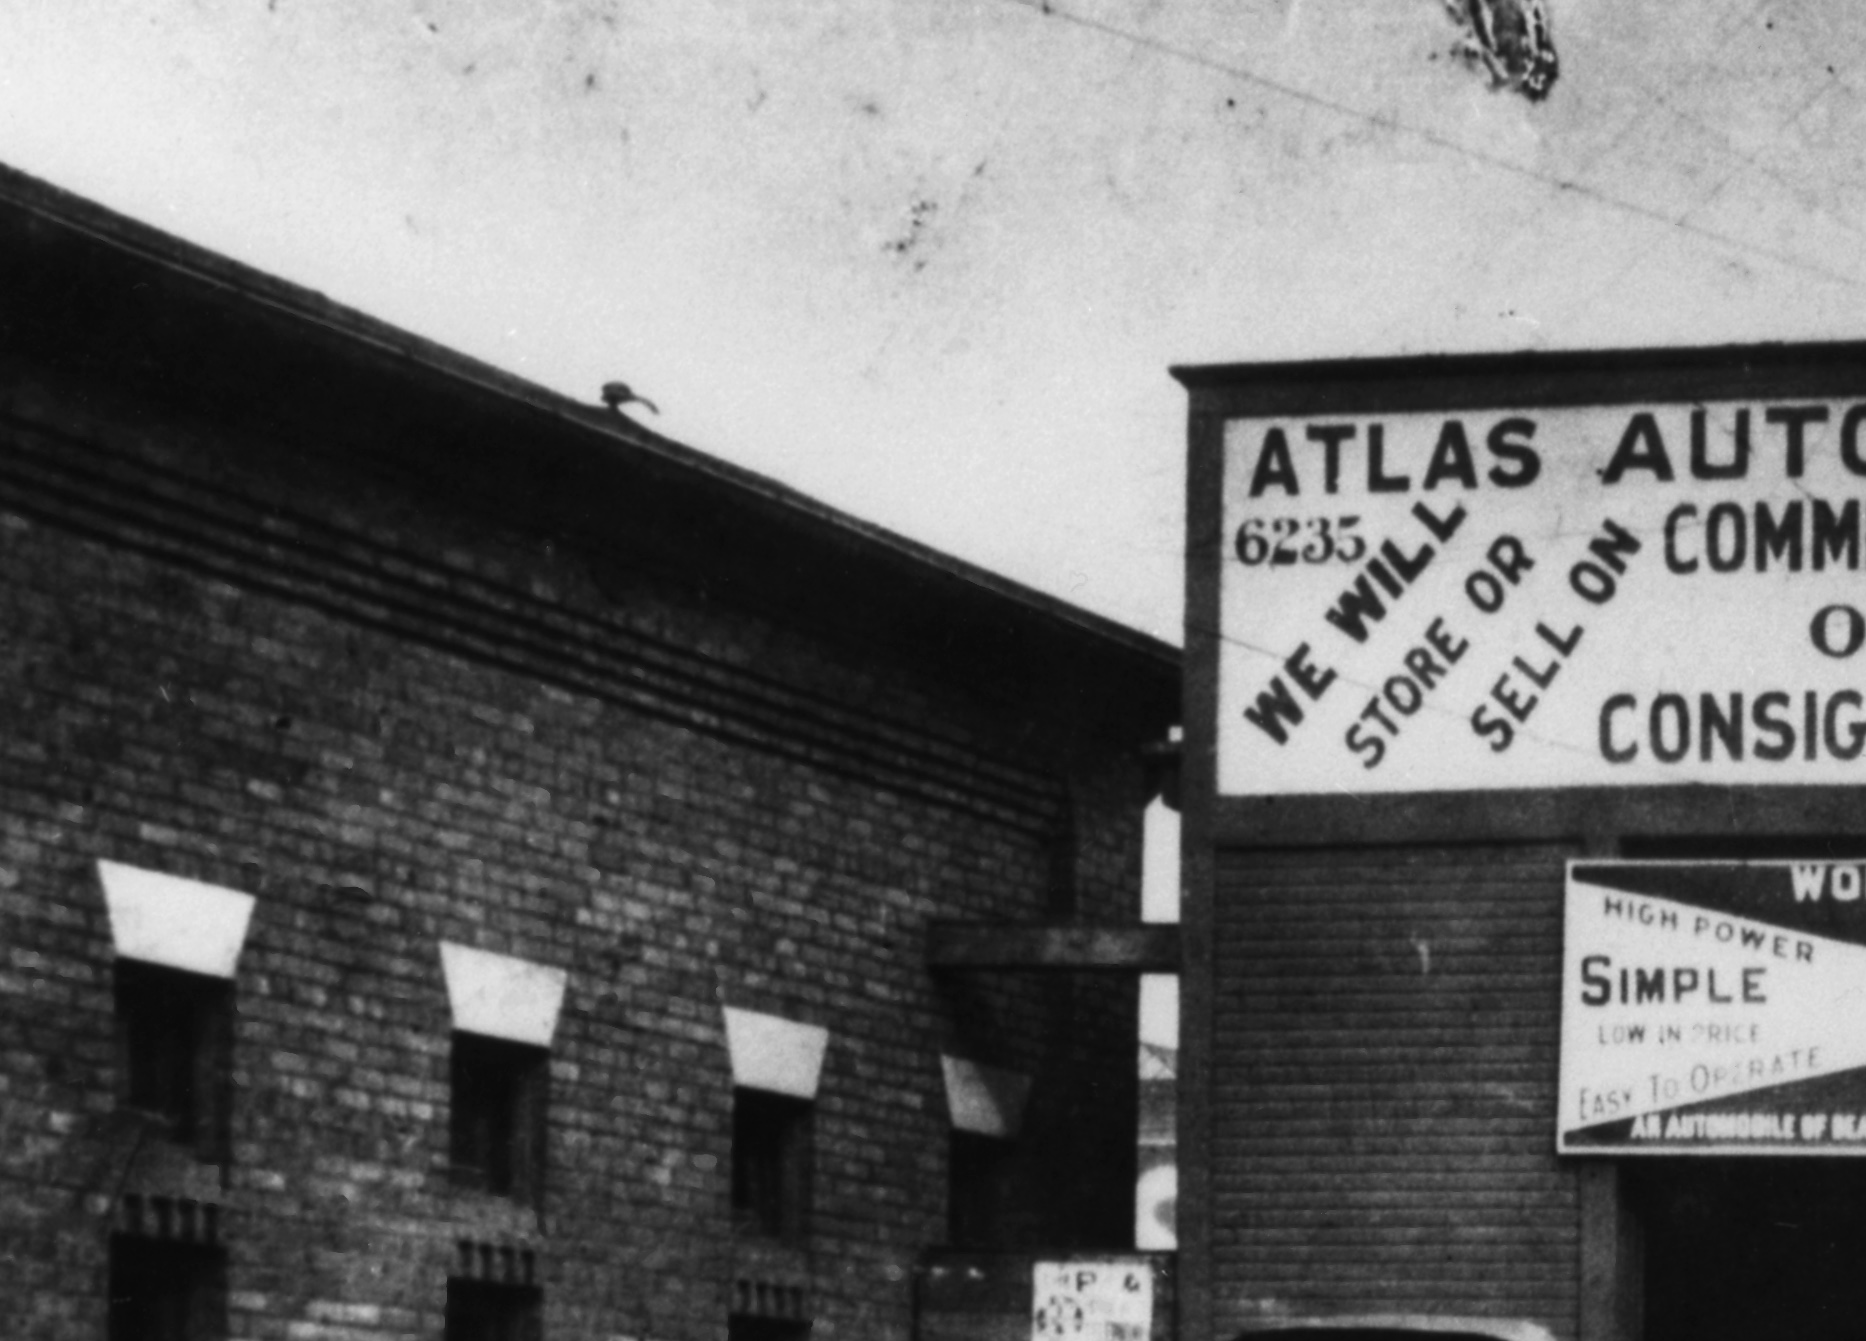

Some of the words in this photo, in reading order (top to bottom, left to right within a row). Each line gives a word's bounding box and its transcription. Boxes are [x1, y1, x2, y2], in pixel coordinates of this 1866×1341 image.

[1249, 417, 1541, 497] ATLAS
[1234, 515, 1367, 566] 6235
[1244, 642, 1337, 746] WE
[1325, 498, 1467, 643] WILL
[1344, 617, 1469, 769] STORE
[1464, 535, 1535, 613] OR
[1470, 620, 1585, 753] SELL
[1569, 519, 1642, 603] ON
[1603, 897, 1680, 929] HIGH
[1694, 916, 1815, 962] POWER
[1580, 955, 1768, 1006] SIMPLE
[1598, 1024, 1646, 1046] LOW
[1658, 1025, 1682, 1045] IN
[1580, 1086, 1632, 1120] EASY
[1650, 1073, 1680, 1102] TO
[1690, 1046, 1822, 1094] OPERATE
[1664, 1113, 1795, 1139] AUTOMOBILE
[1801, 1114, 1828, 1139] OF
